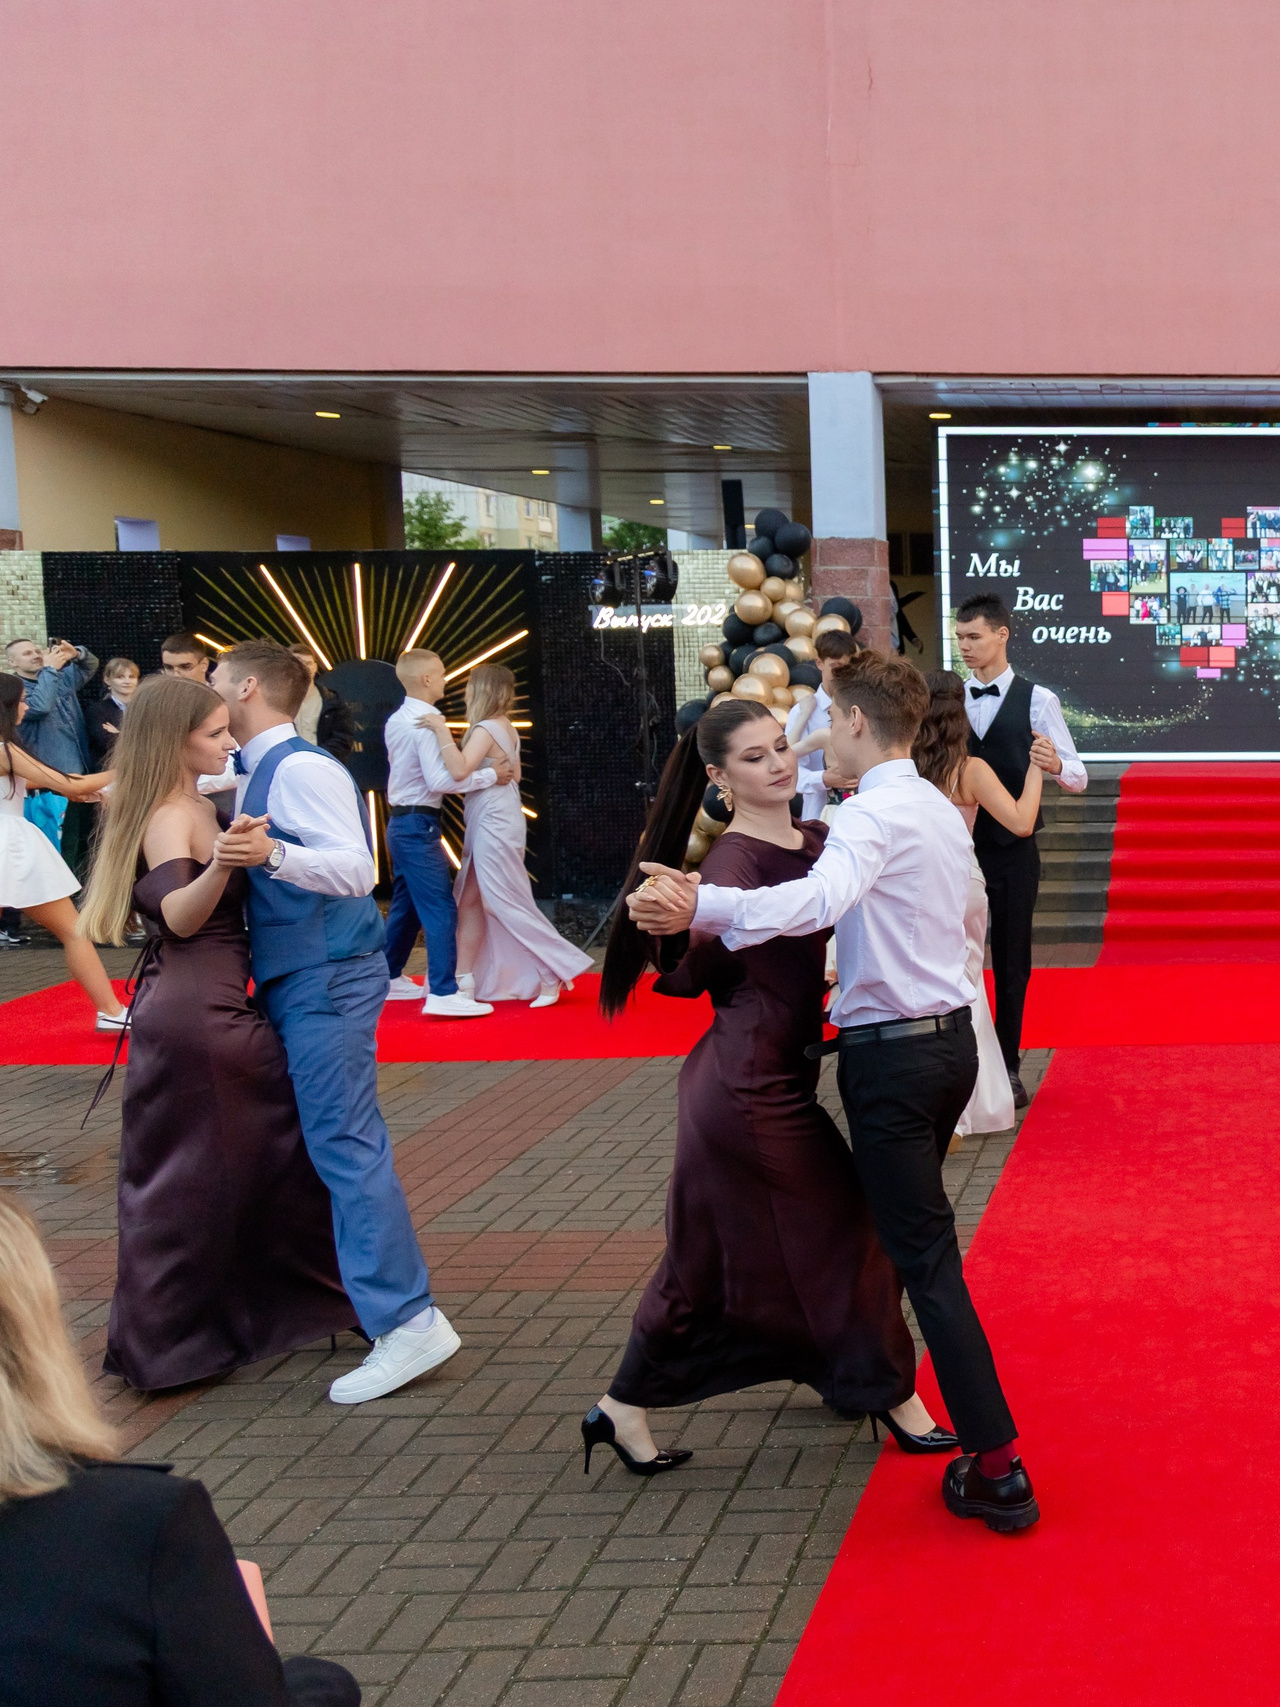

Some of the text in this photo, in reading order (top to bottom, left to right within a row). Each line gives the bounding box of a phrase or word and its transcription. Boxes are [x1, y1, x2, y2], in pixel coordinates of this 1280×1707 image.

[966, 552, 1021, 578] Мы
[1013, 587, 1064, 612] Вас
[593, 603, 727, 633] Выпуск 202
[1032, 625, 1112, 645] очень
